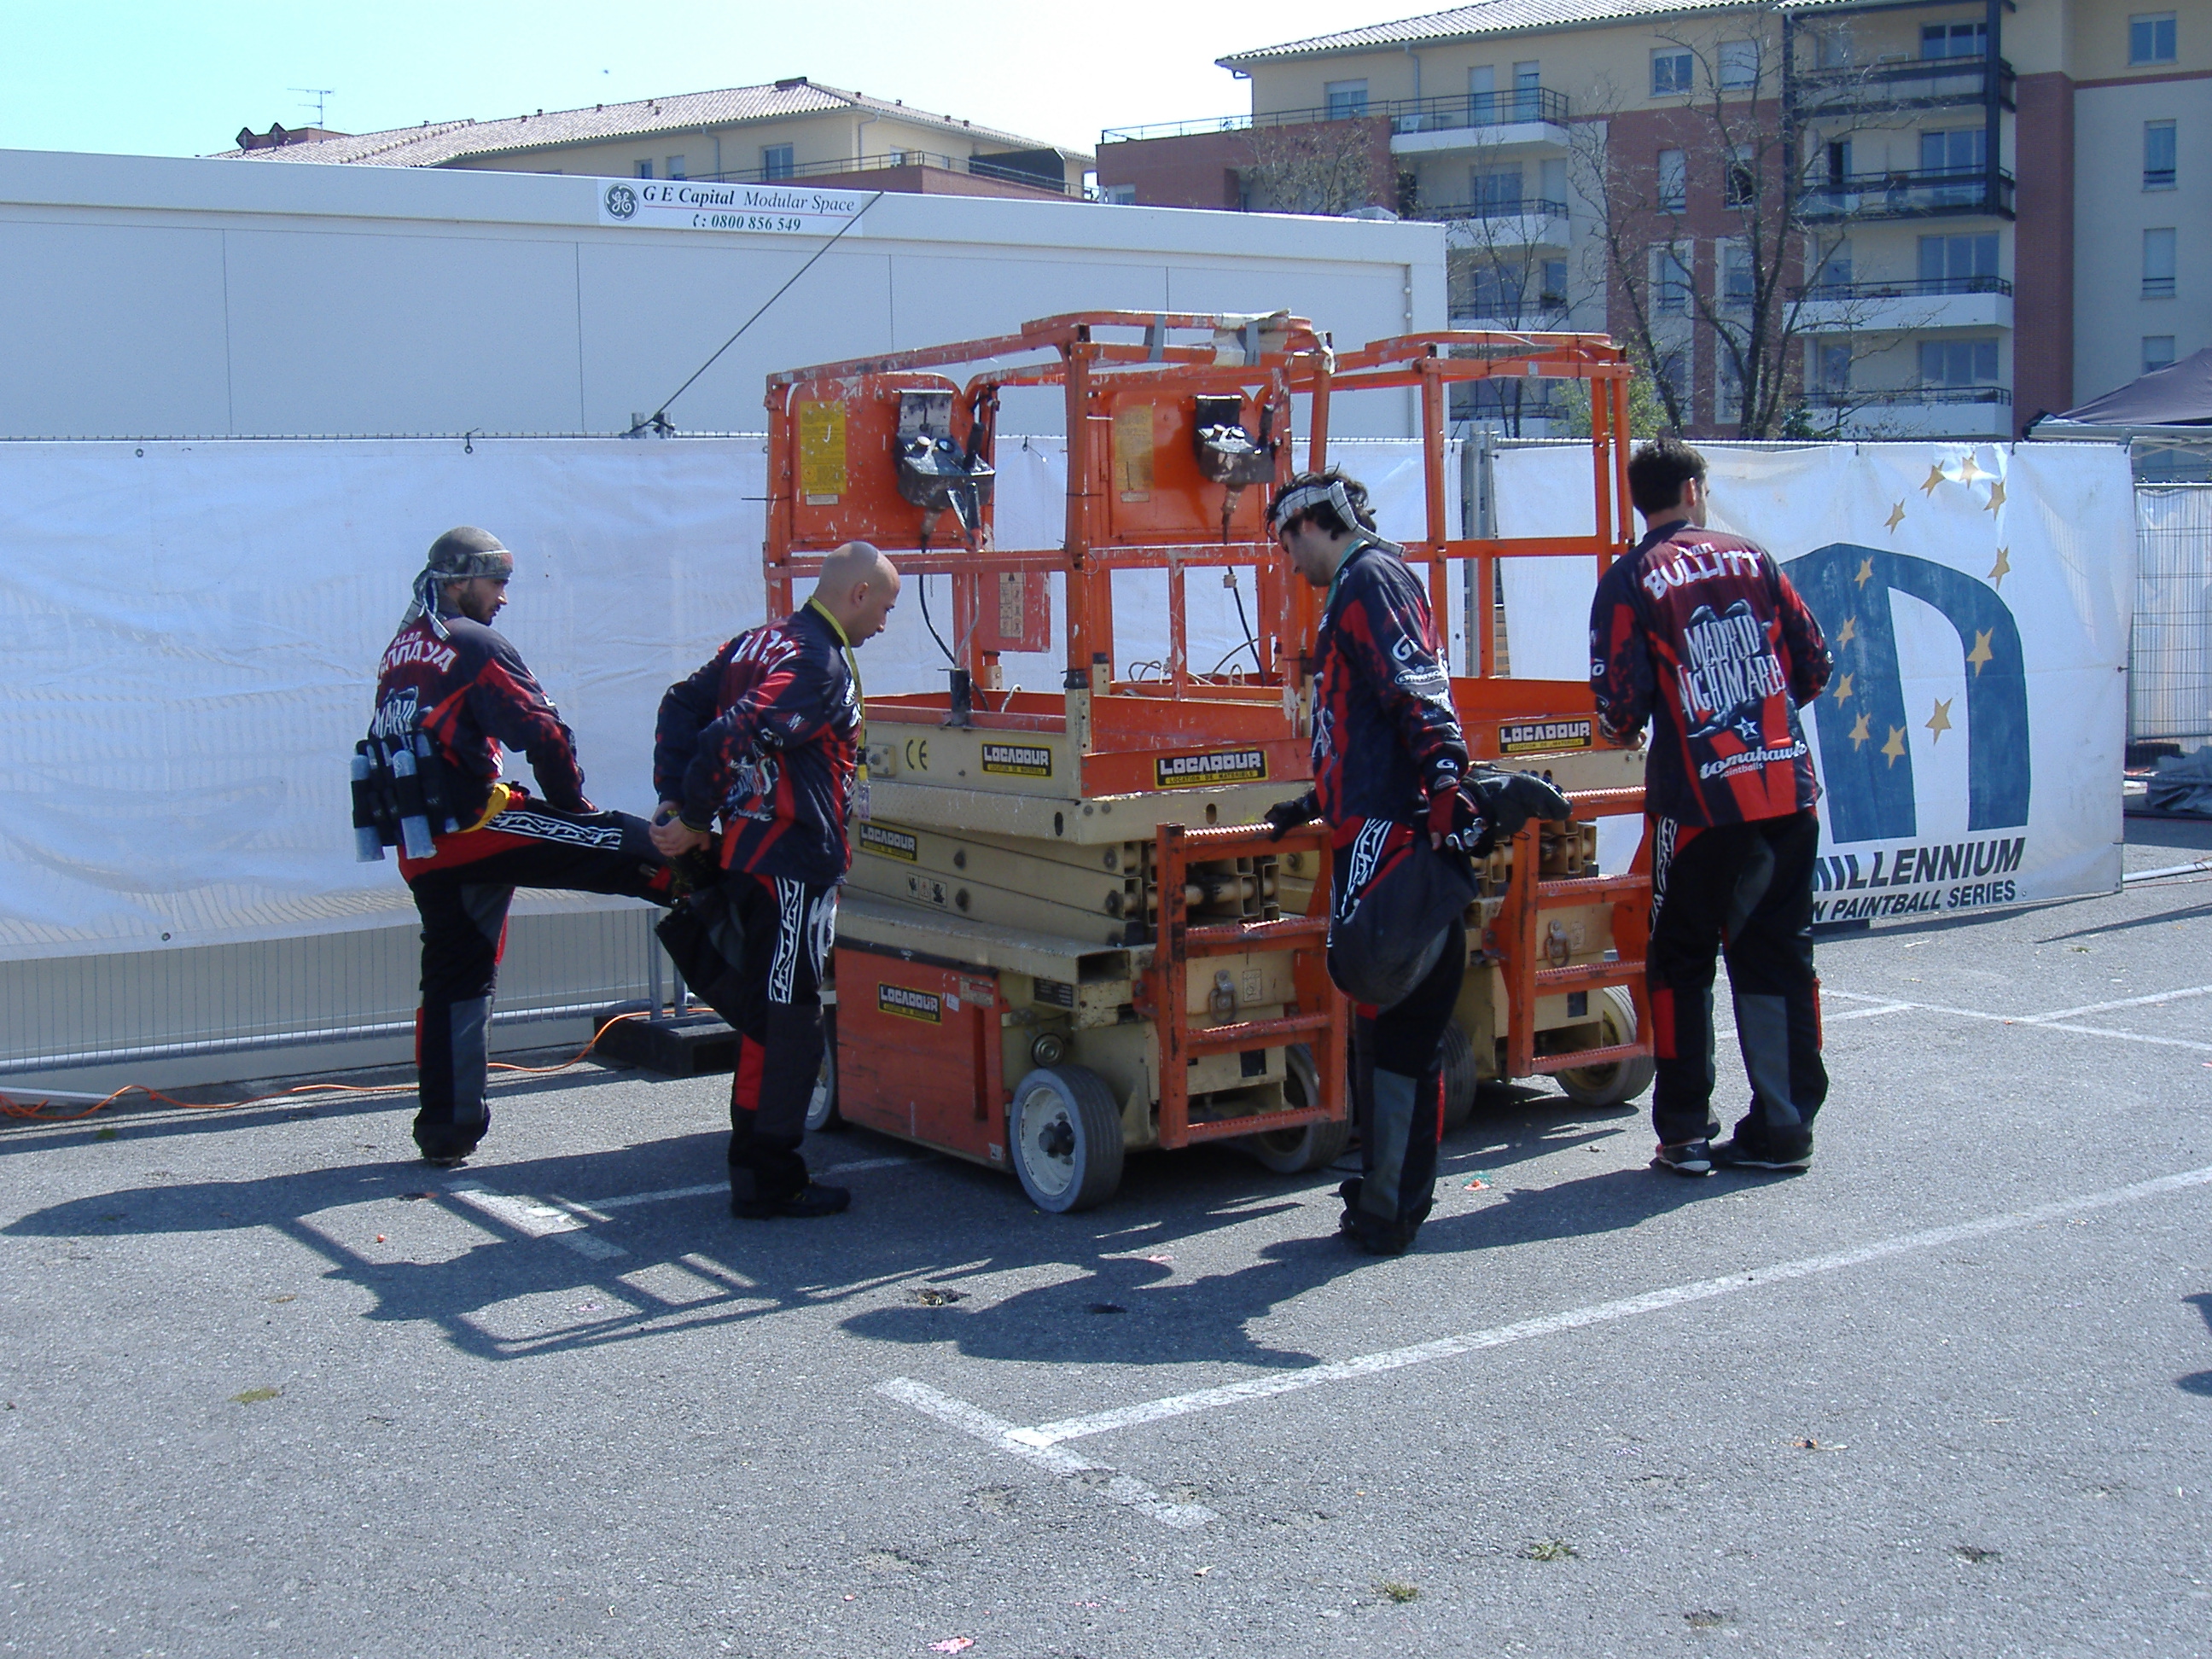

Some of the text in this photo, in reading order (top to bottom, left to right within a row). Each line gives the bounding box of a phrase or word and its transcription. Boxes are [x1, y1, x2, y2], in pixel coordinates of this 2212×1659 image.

[643, 185, 854, 213] G E Capital Modular Space
[711, 213, 801, 231] 0800 856 549
[1643, 550, 1762, 600] BULLITT
[1683, 614, 1761, 671] MADRID
[1499, 721, 1591, 744] LOCADOUR
[983, 746, 1050, 766] LOCADOUR
[1160, 752, 1262, 776] LOCADOUR
[1699, 739, 1807, 780] tomahawk
[860, 824, 917, 852] LOCADOUR
[1830, 889, 1941, 921] PAINTBALL
[1947, 879, 2017, 909] SERIES
[879, 985, 939, 1012] LOCADOUR
